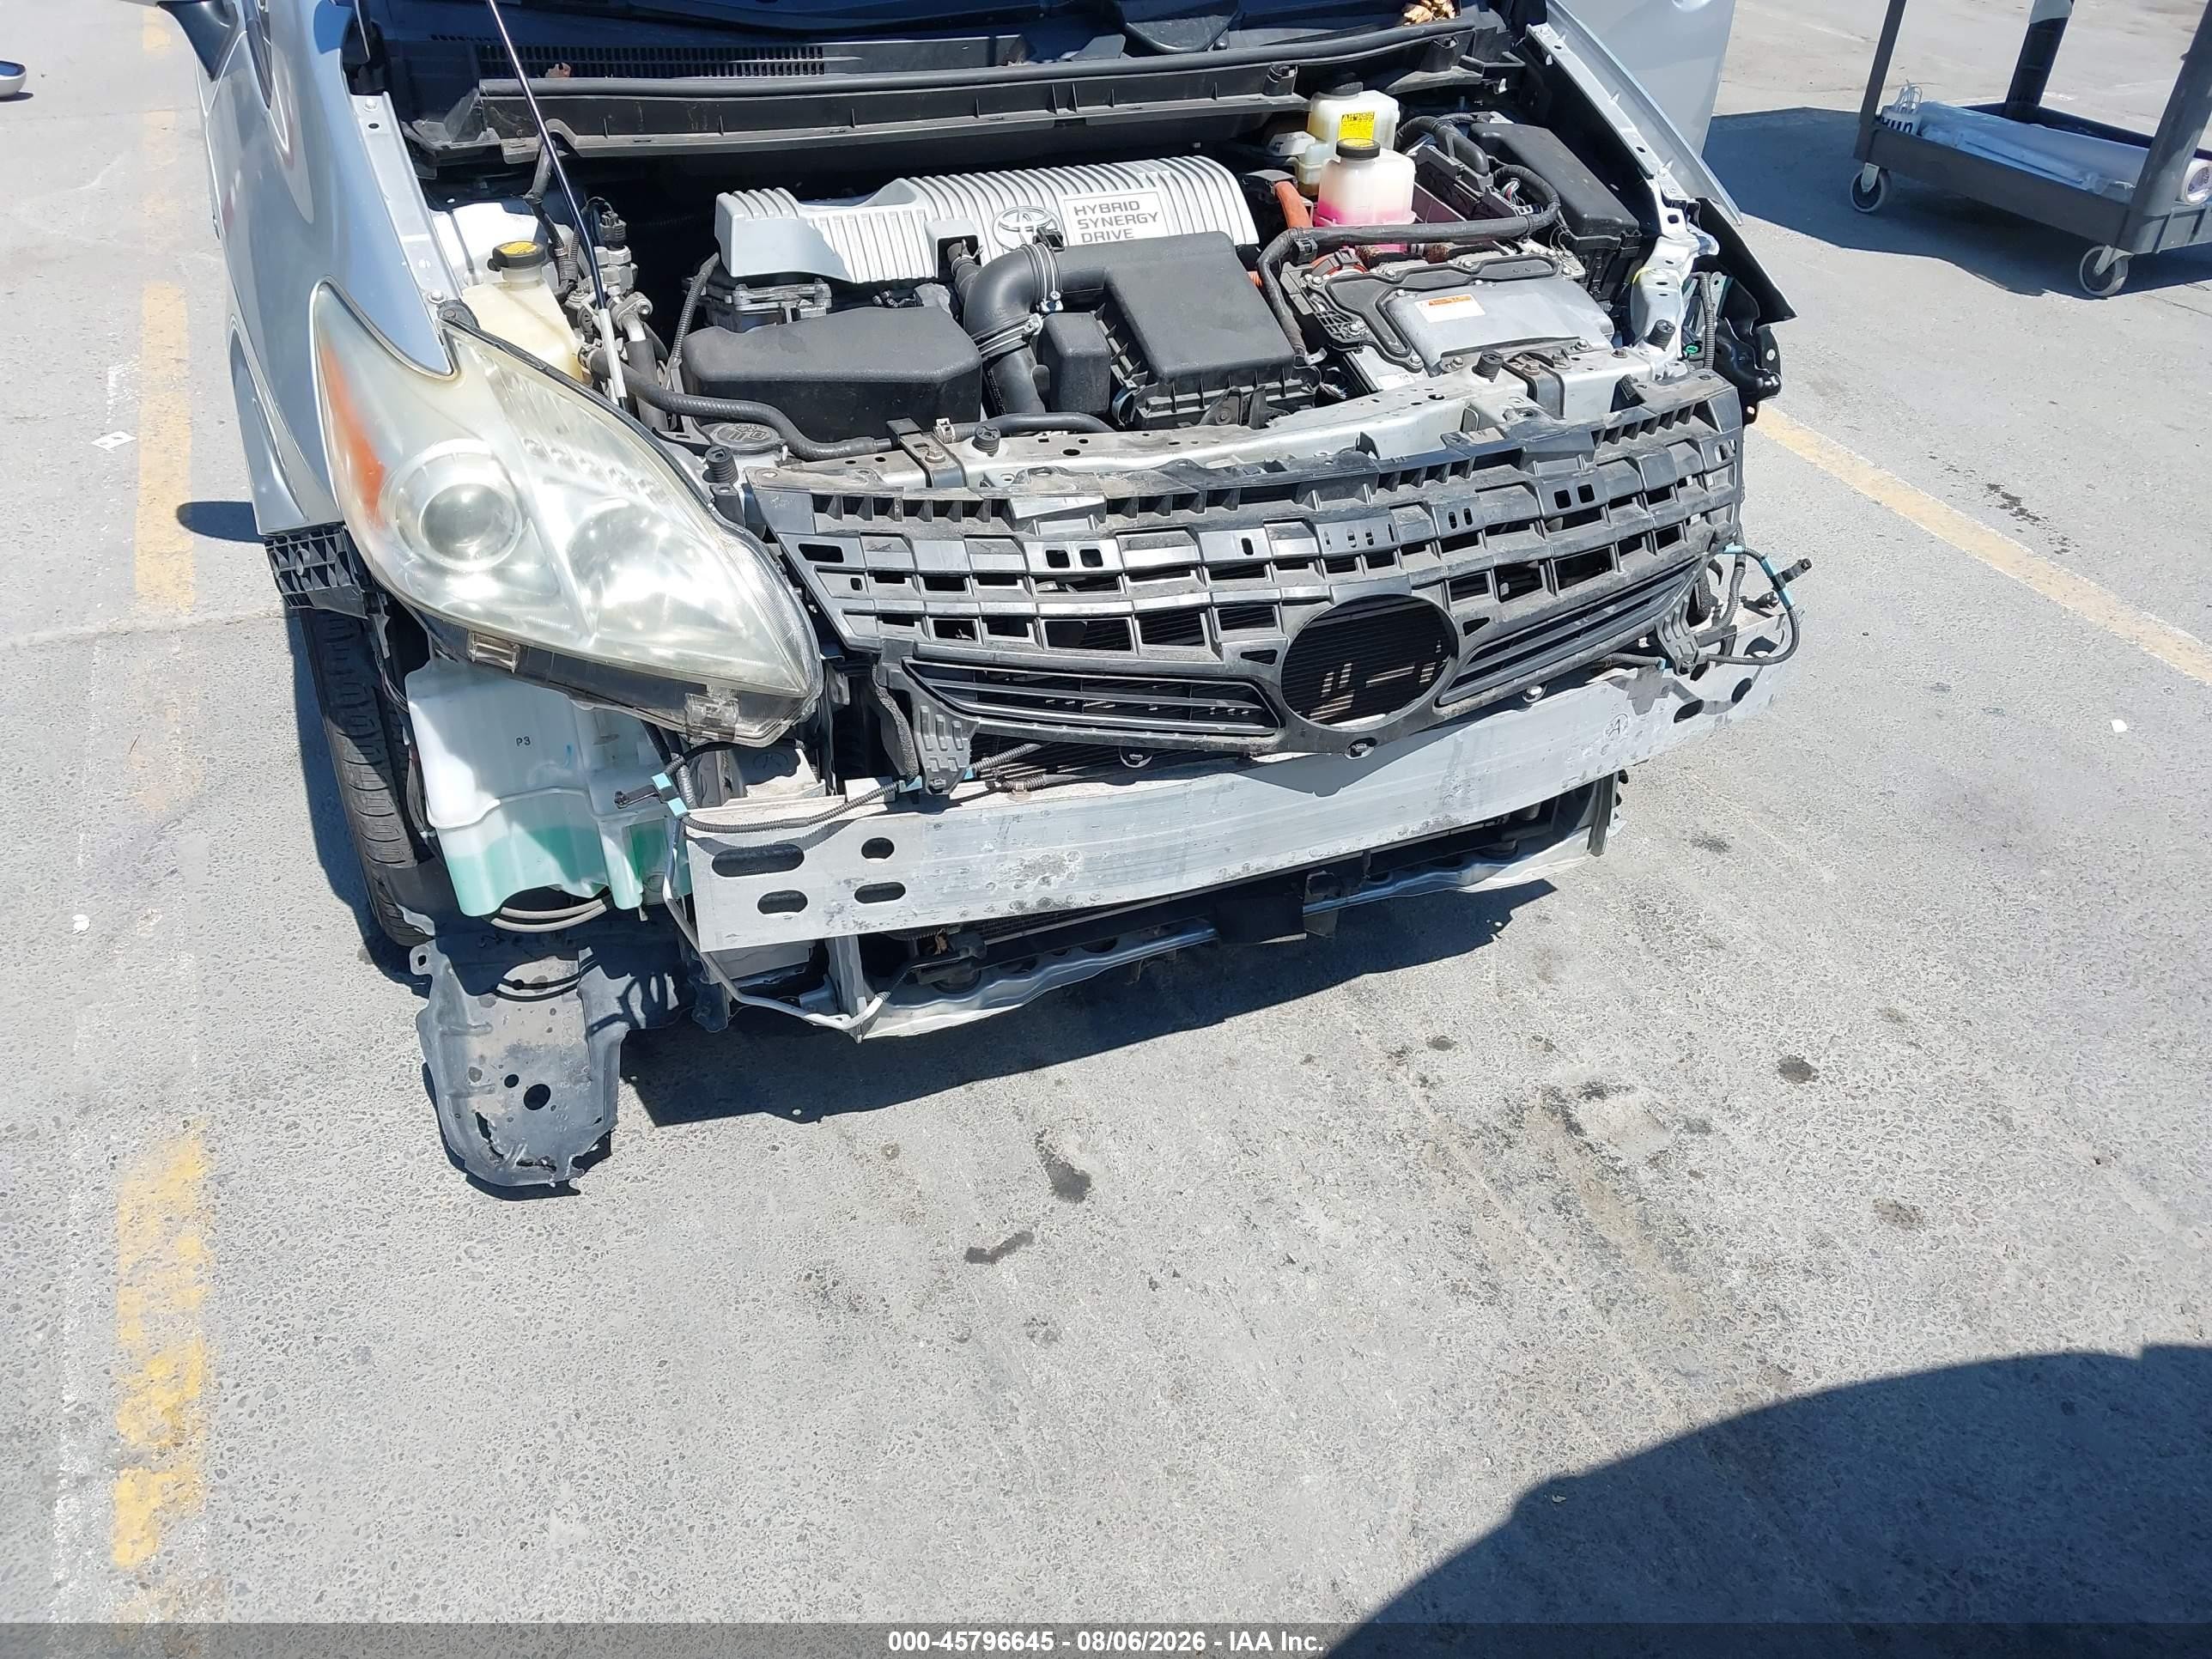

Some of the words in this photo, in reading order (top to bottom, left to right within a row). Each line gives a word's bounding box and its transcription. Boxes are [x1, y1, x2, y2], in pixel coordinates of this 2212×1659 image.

[1073, 200, 1140, 216] HYBRID
[1077, 211, 1159, 230] SYNERGY
[1080, 228, 1134, 244] DRIVE
[515, 736, 532, 747] P3
